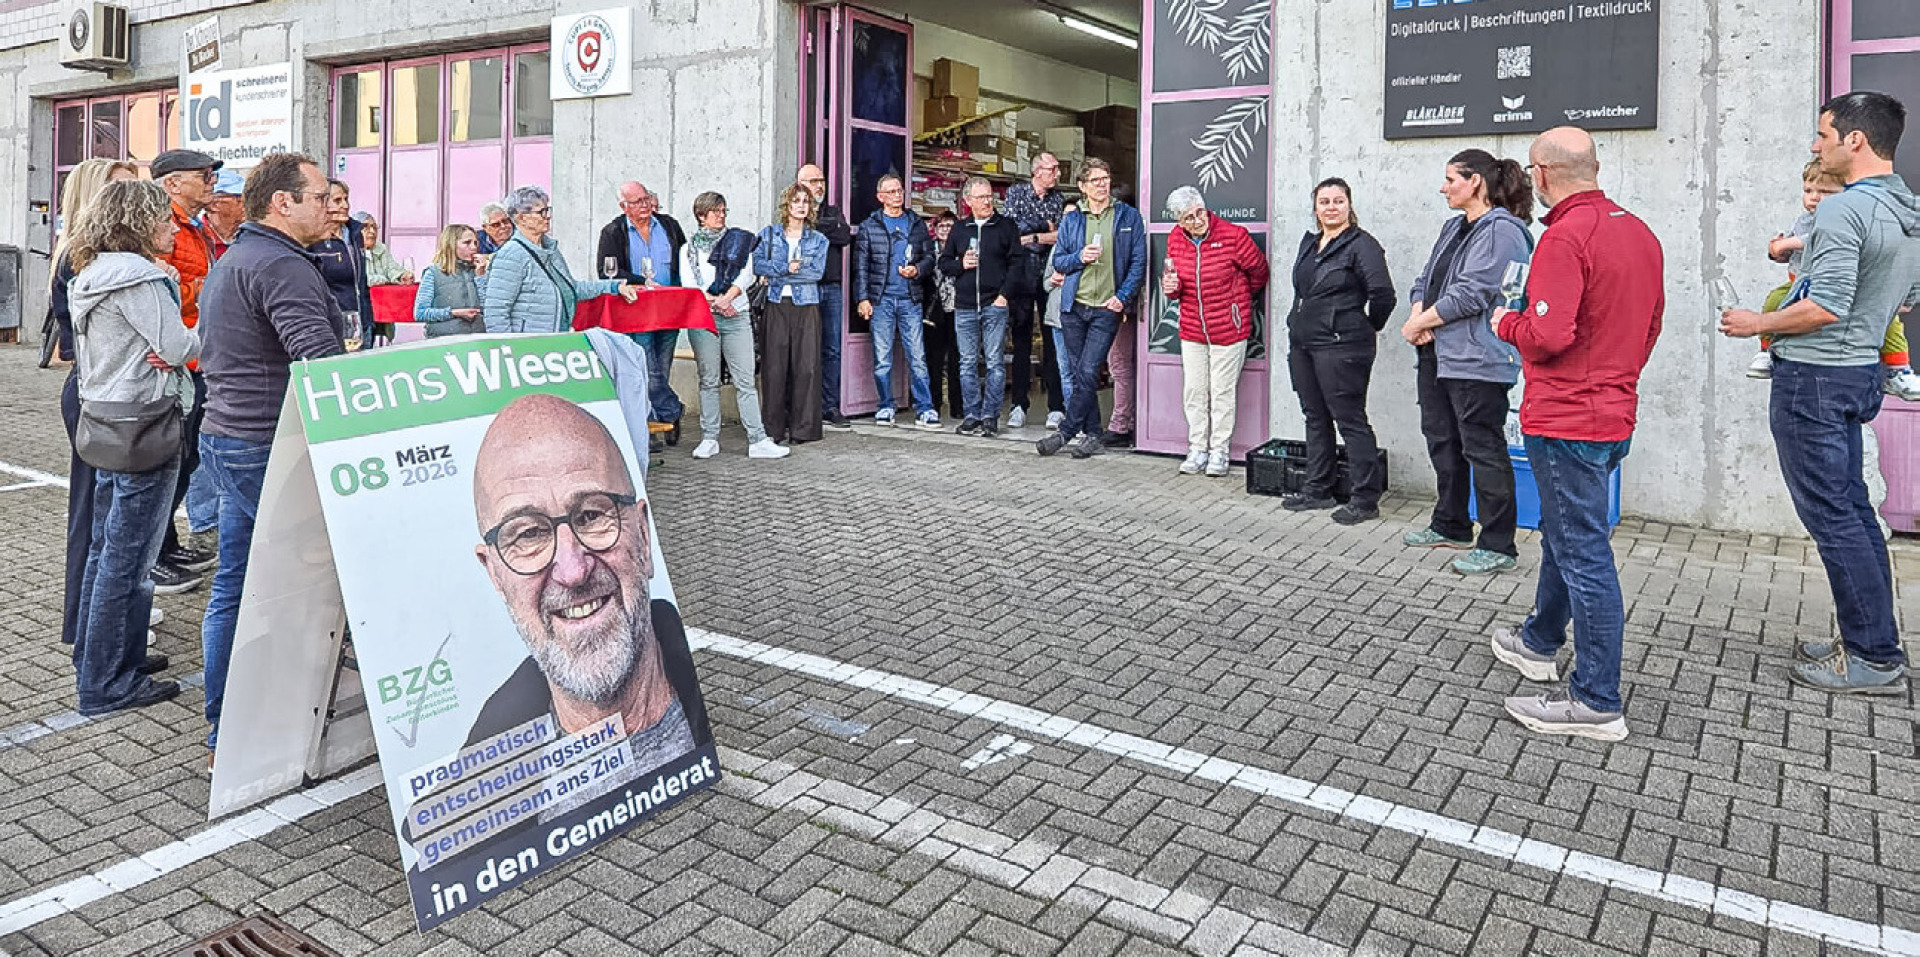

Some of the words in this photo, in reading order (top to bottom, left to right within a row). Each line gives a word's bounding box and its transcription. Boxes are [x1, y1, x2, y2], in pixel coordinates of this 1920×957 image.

[1391, 18, 1460, 37] Digitaldruck
[1471, 9, 1566, 29] Beschriftungen
[1577, 0, 1652, 19] Textildruck
[1391, 75, 1428, 87] offizieller
[1430, 73, 1462, 84] Händler
[190, 80, 232, 141] id
[1405, 105, 1465, 120] BLÅKLÄDER
[1493, 111, 1533, 122] erima
[1585, 105, 1640, 118] switcher
[1220, 208, 1257, 218] HUNDE
[303, 366, 447, 422] Hans
[330, 457, 389, 497] 08
[396, 444, 453, 467] März
[401, 459, 457, 486] 2026
[377, 658, 453, 704] BZG
[410, 722, 547, 797] pragmatisch
[416, 722, 616, 825] entscheidungsstark
[424, 788, 552, 863] gemeinsam
[556, 770, 589, 796] ans
[592, 748, 625, 780] Ziel
[430, 884, 466, 918] in
[476, 848, 539, 894] den
[546, 755, 716, 857] Gemeinderat
